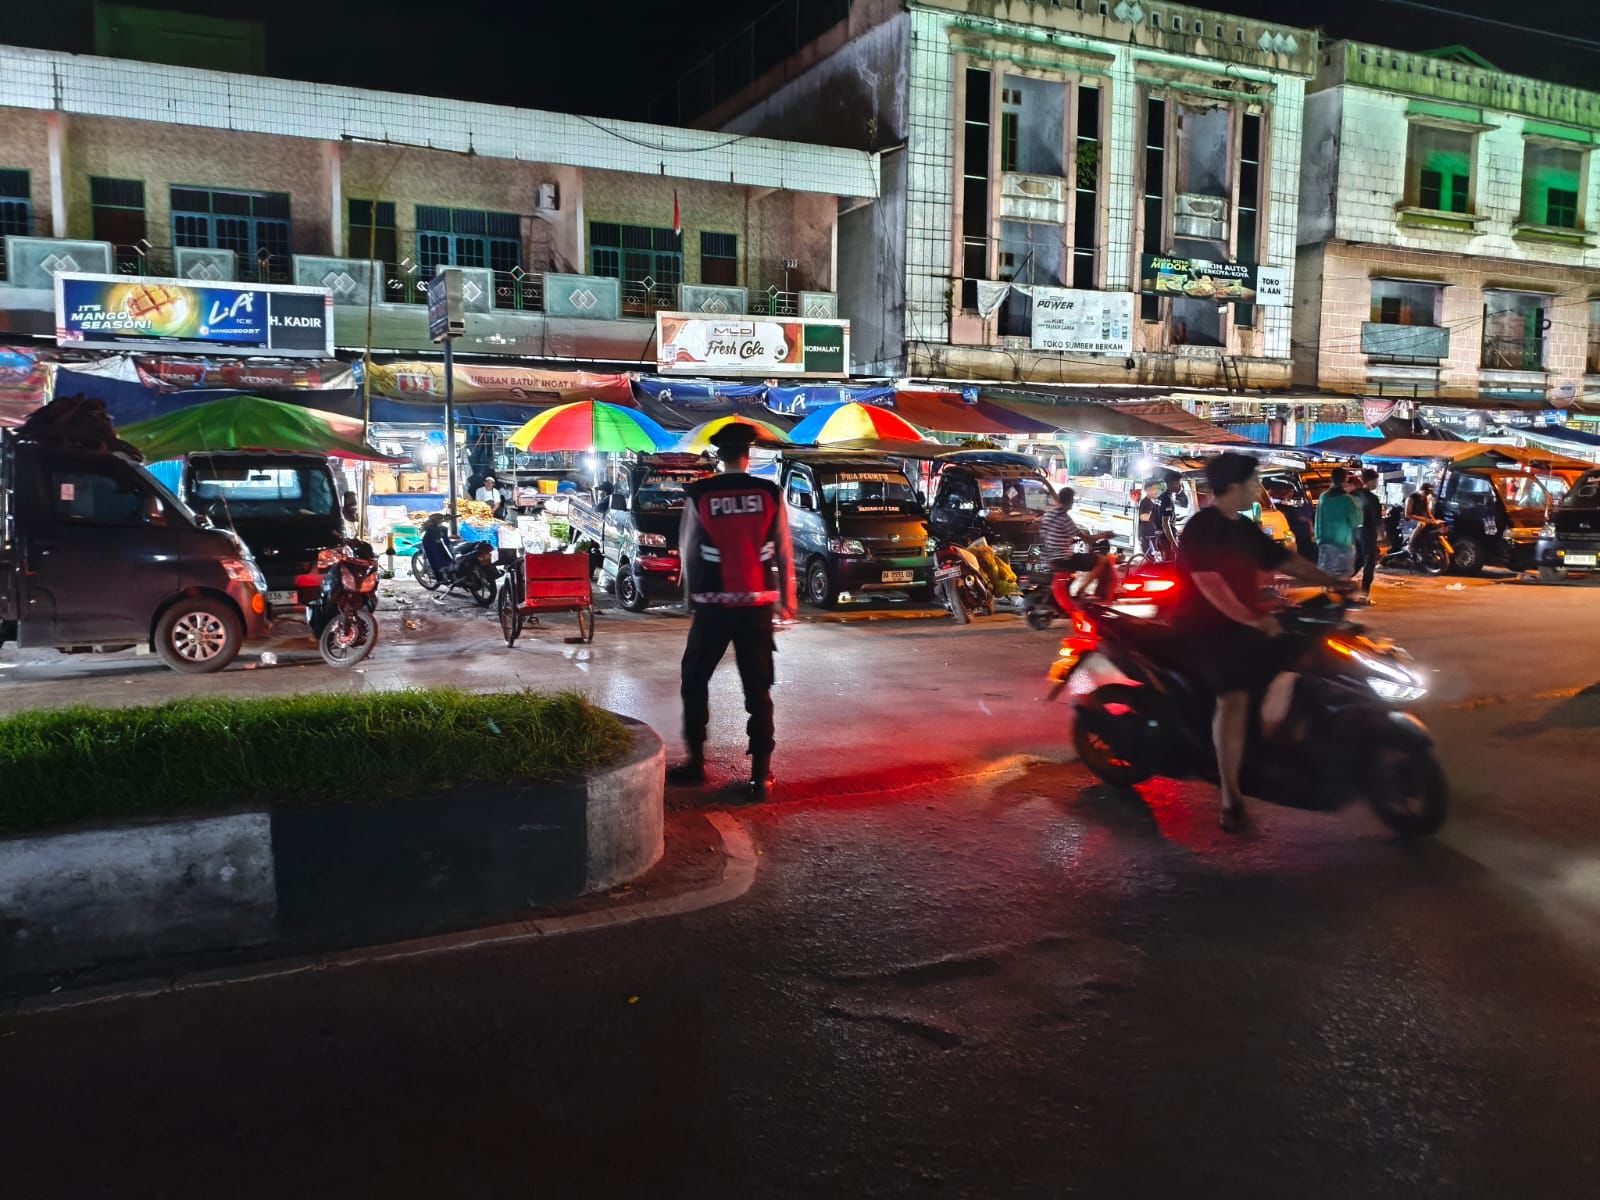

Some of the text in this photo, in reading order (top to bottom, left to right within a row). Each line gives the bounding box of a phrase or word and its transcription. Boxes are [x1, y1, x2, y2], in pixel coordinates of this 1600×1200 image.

[1150, 261, 1189, 272] MEDOK
[1224, 265, 1249, 273] AUTO
[1262, 277, 1280, 286] TOKO
[78, 304, 102, 312] IT'S
[1036, 299, 1075, 310] POWER
[71, 311, 129, 321] MANGO
[80, 319, 153, 330] SEASON!
[284, 316, 322, 328] KADIR
[704, 339, 765, 360] Fresh Cola
[1043, 340, 1123, 351] TOKO SUMBER BERKAH
[471, 375, 508, 385] URUSAN
[541, 378, 569, 388] INGAT
[709, 494, 764, 516] POLISI
